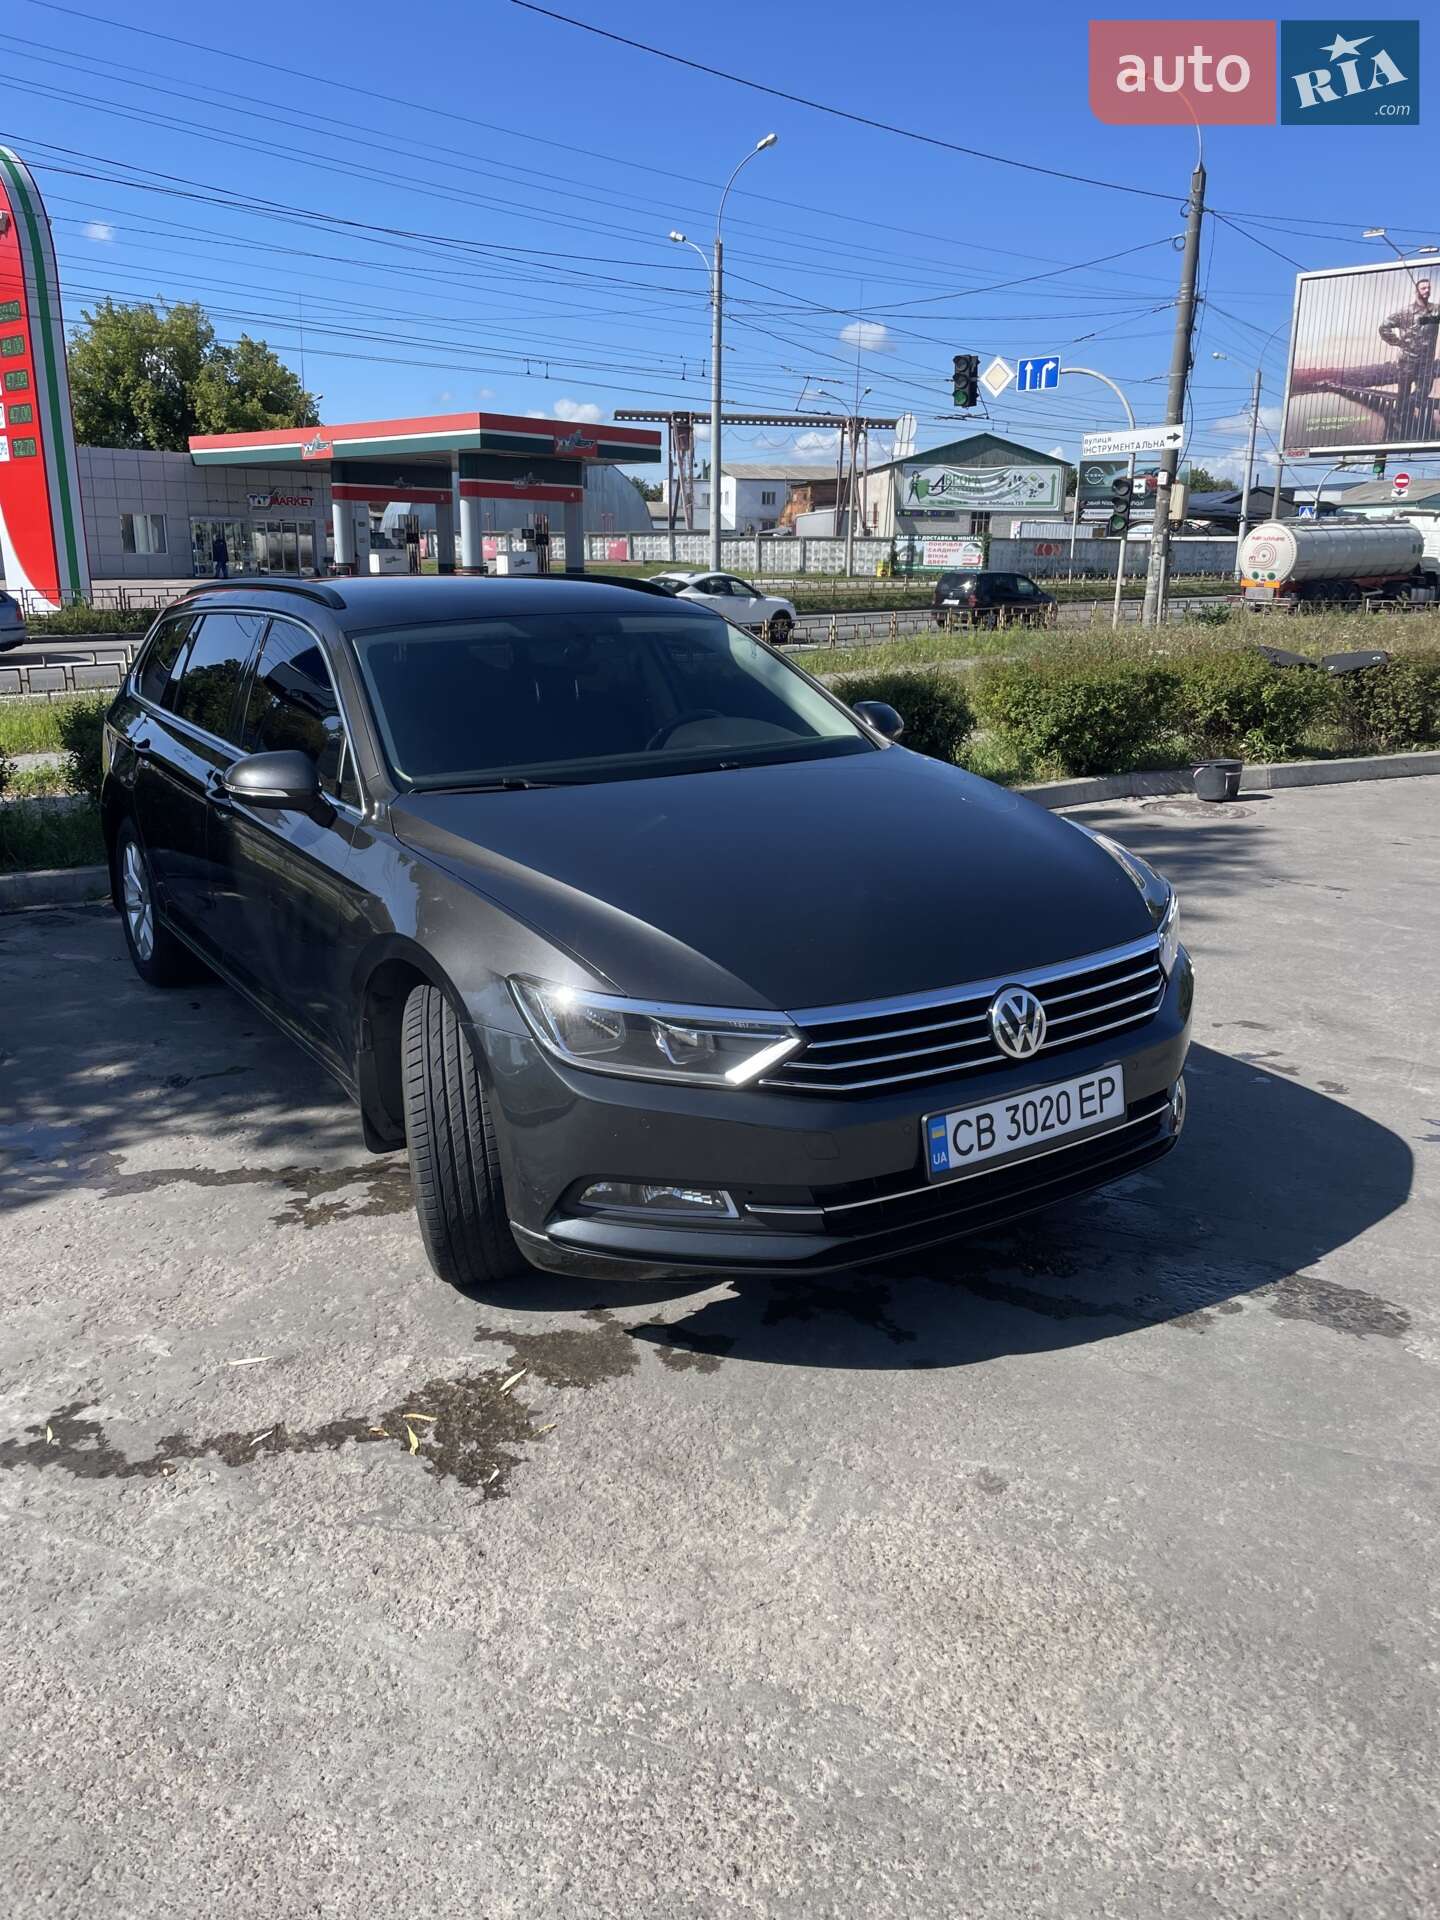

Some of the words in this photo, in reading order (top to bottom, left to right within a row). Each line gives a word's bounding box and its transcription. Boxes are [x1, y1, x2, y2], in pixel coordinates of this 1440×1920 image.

[1084, 436, 1112, 445] вулиця
[1084, 440, 1165, 454] ІНСТРУМЕНТАЛЬНА
[952, 1112, 996, 1157] CB
[1005, 1090, 1072, 1142] 3020
[1078, 1075, 1116, 1120] EP
[932, 1155, 948, 1166] UA
